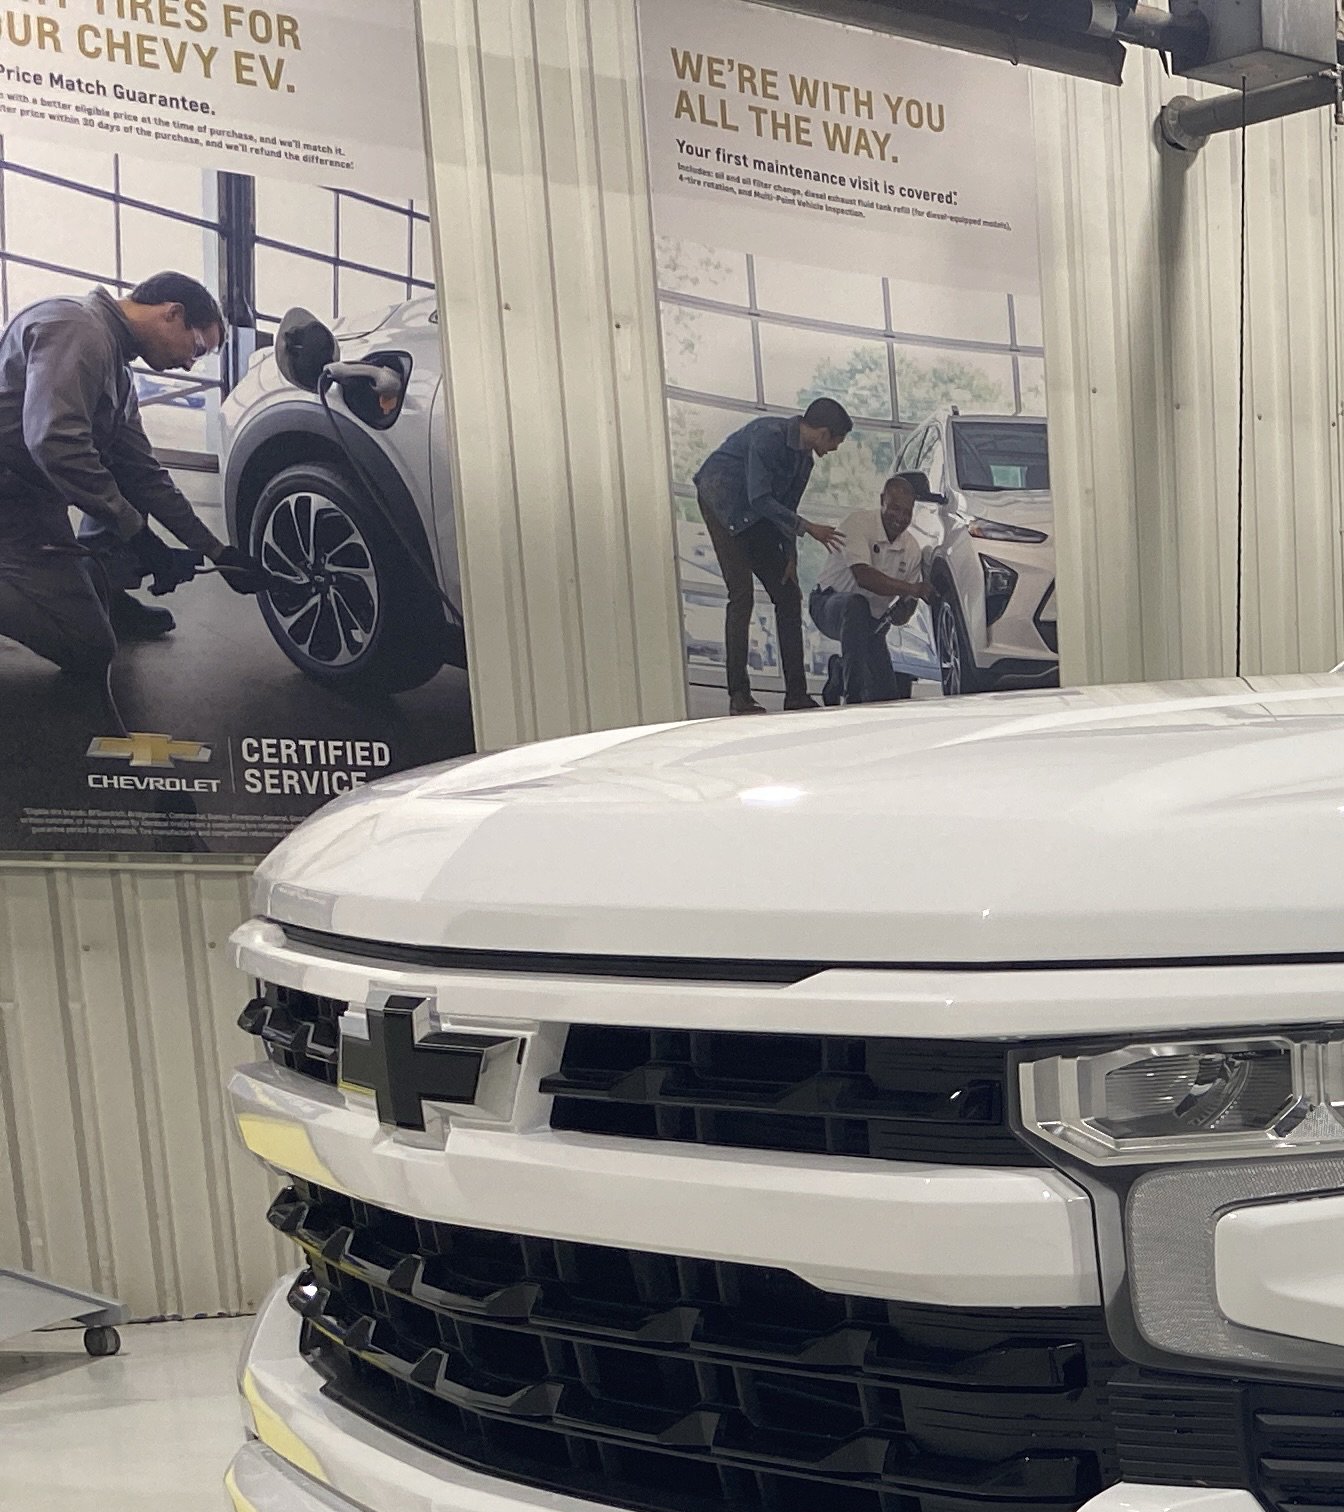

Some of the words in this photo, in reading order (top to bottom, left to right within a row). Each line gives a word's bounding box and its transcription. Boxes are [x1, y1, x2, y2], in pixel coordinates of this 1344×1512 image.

[0, 10, 63, 53] UR
[77, 23, 218, 79] CHEVY
[234, 50, 296, 93] EV.
[224, 4, 302, 50] FOR
[49, 73, 107, 97] Match
[113, 84, 216, 116] Guarantee.
[670, 47, 780, 101] WE'RE
[789, 73, 874, 120] WITH
[883, 93, 946, 133] YOU
[20, 108, 45, 120] price
[48, 113, 79, 126] within
[98, 121, 120, 132] days
[123, 125, 133, 133] of
[136, 127, 152, 137] the
[155, 131, 203, 147] purchase,
[206, 139, 222, 148] and
[249, 146, 282, 158] refund
[284, 151, 299, 161] the
[41, 98, 71, 110] better
[75, 105, 110, 118] eligible
[113, 112, 138, 123] price
[141, 116, 151, 124] at
[154, 117, 169, 127] the
[173, 121, 194, 132] time
[197, 124, 207, 133] of
[209, 127, 257, 143] purchase,
[259, 134, 276, 145] and
[303, 142, 333, 154] match
[674, 89, 740, 132] ALL
[748, 104, 813, 148] THE
[822, 120, 899, 163] WAY.
[676, 139, 711, 159] Your
[716, 147, 749, 168] first
[753, 158, 846, 187] maintenance
[850, 175, 880, 193] visit
[883, 180, 895, 195] is
[715, 170, 724, 180] oil
[726, 174, 741, 184] and
[738, 187, 752, 197] and
[242, 737, 390, 767] CERTIFIED
[88, 774, 220, 793] CHEVROLET
